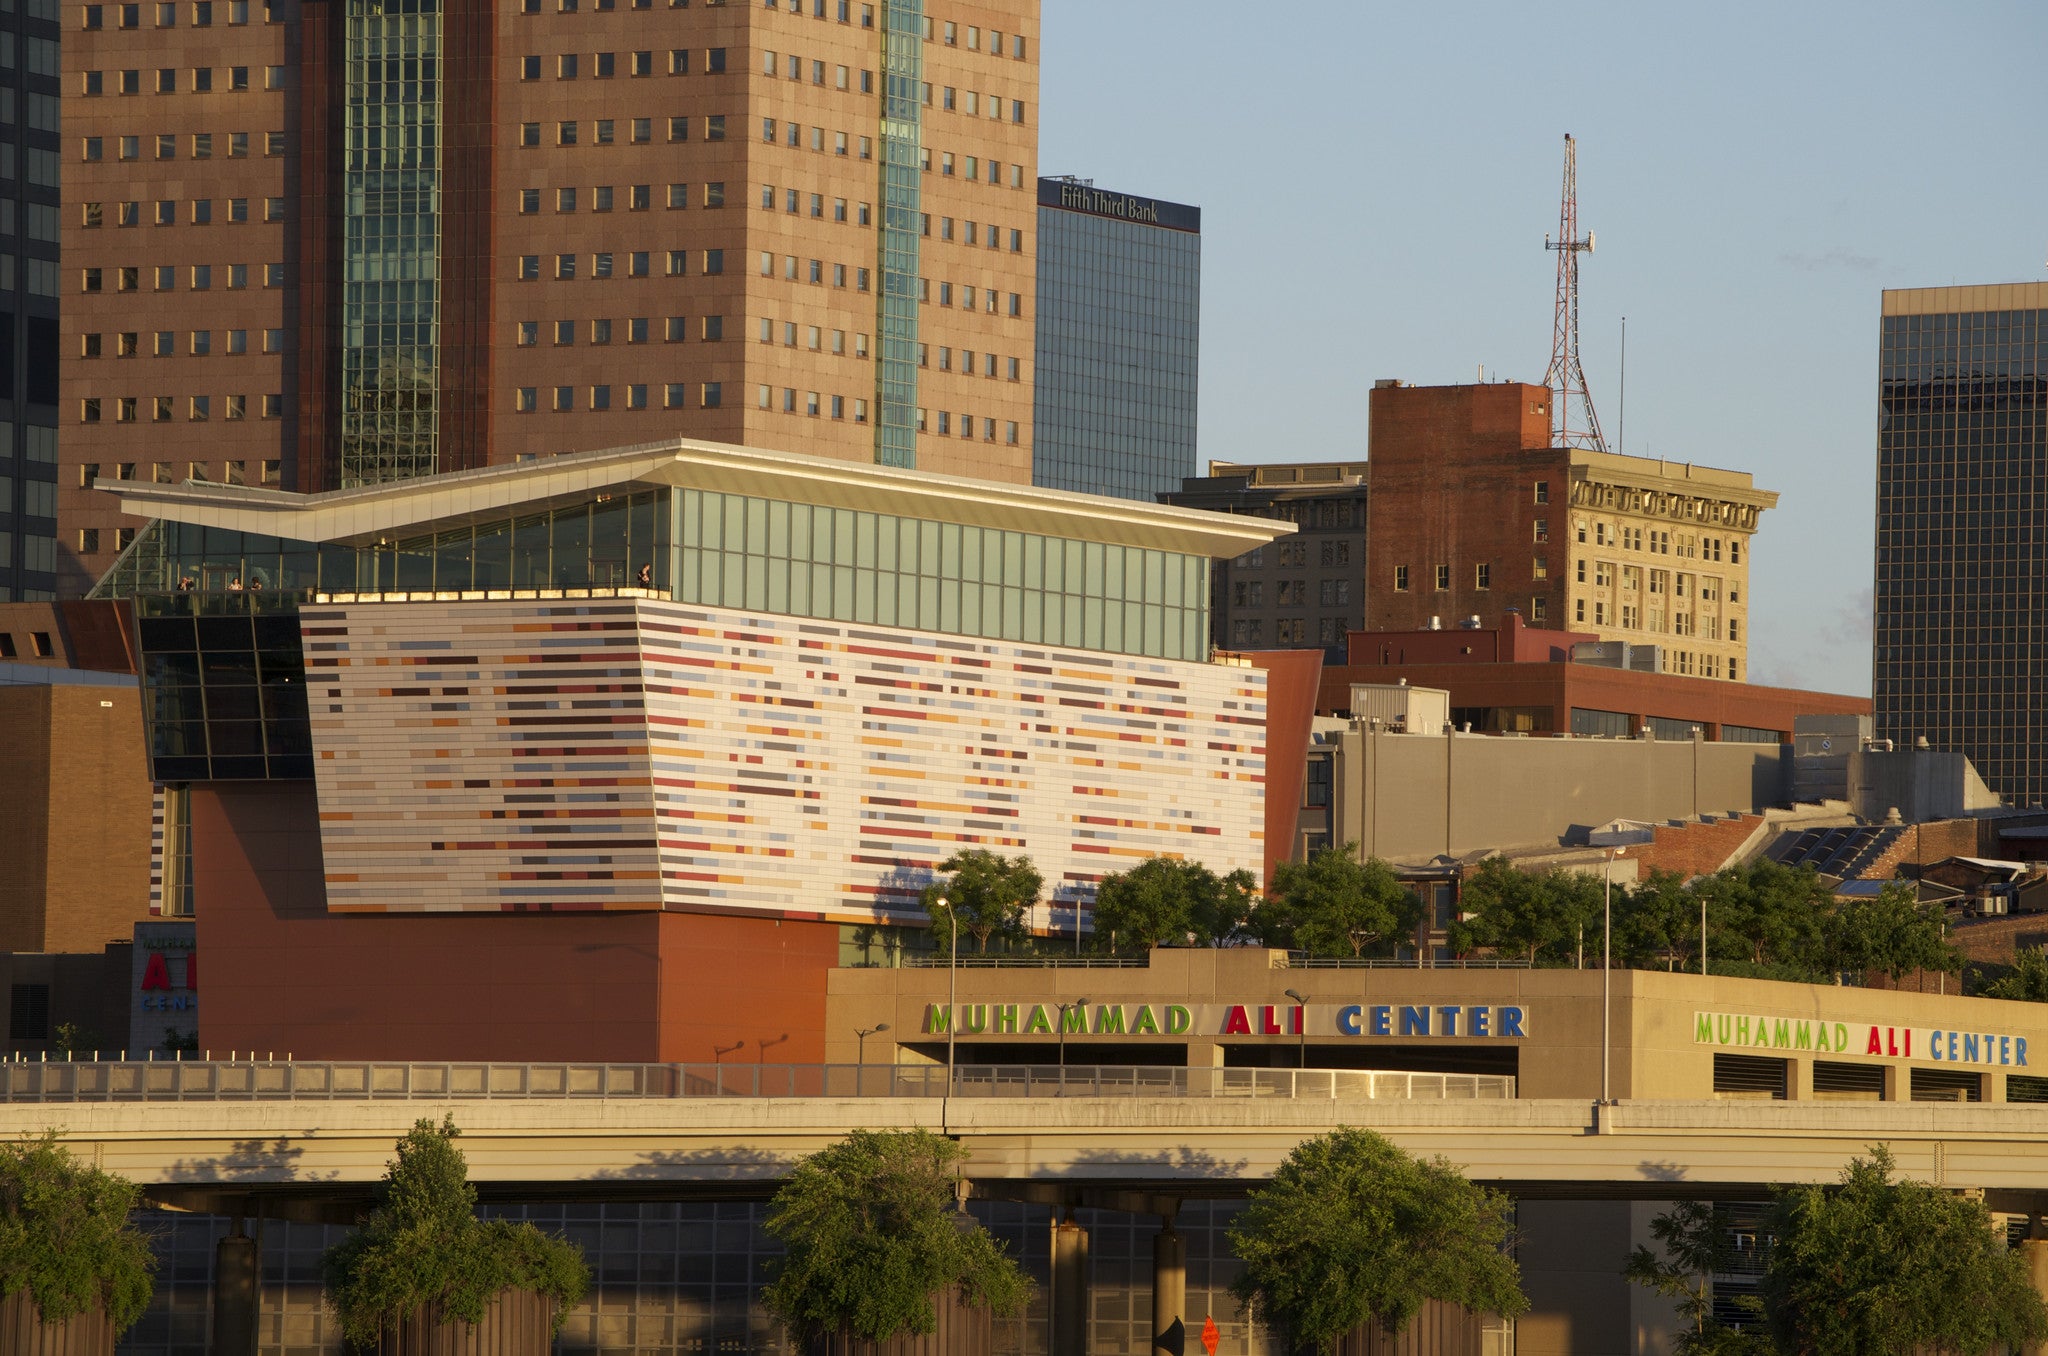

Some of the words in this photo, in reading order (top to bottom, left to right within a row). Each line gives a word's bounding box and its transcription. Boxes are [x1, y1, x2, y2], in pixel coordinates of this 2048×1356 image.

[1061, 186, 1090, 210] Fifth
[1093, 192, 1125, 217] Third
[1128, 198, 1158, 222] Bank
[929, 1003, 1193, 1035] MUHAMMAD
[1226, 1004, 1304, 1035] ALI
[1341, 1004, 1526, 1037] CENTER
[1697, 1013, 1849, 1053] MUHAMMAD
[1867, 1026, 1911, 1057] ALI
[1930, 1030, 2029, 1066] CENTER
